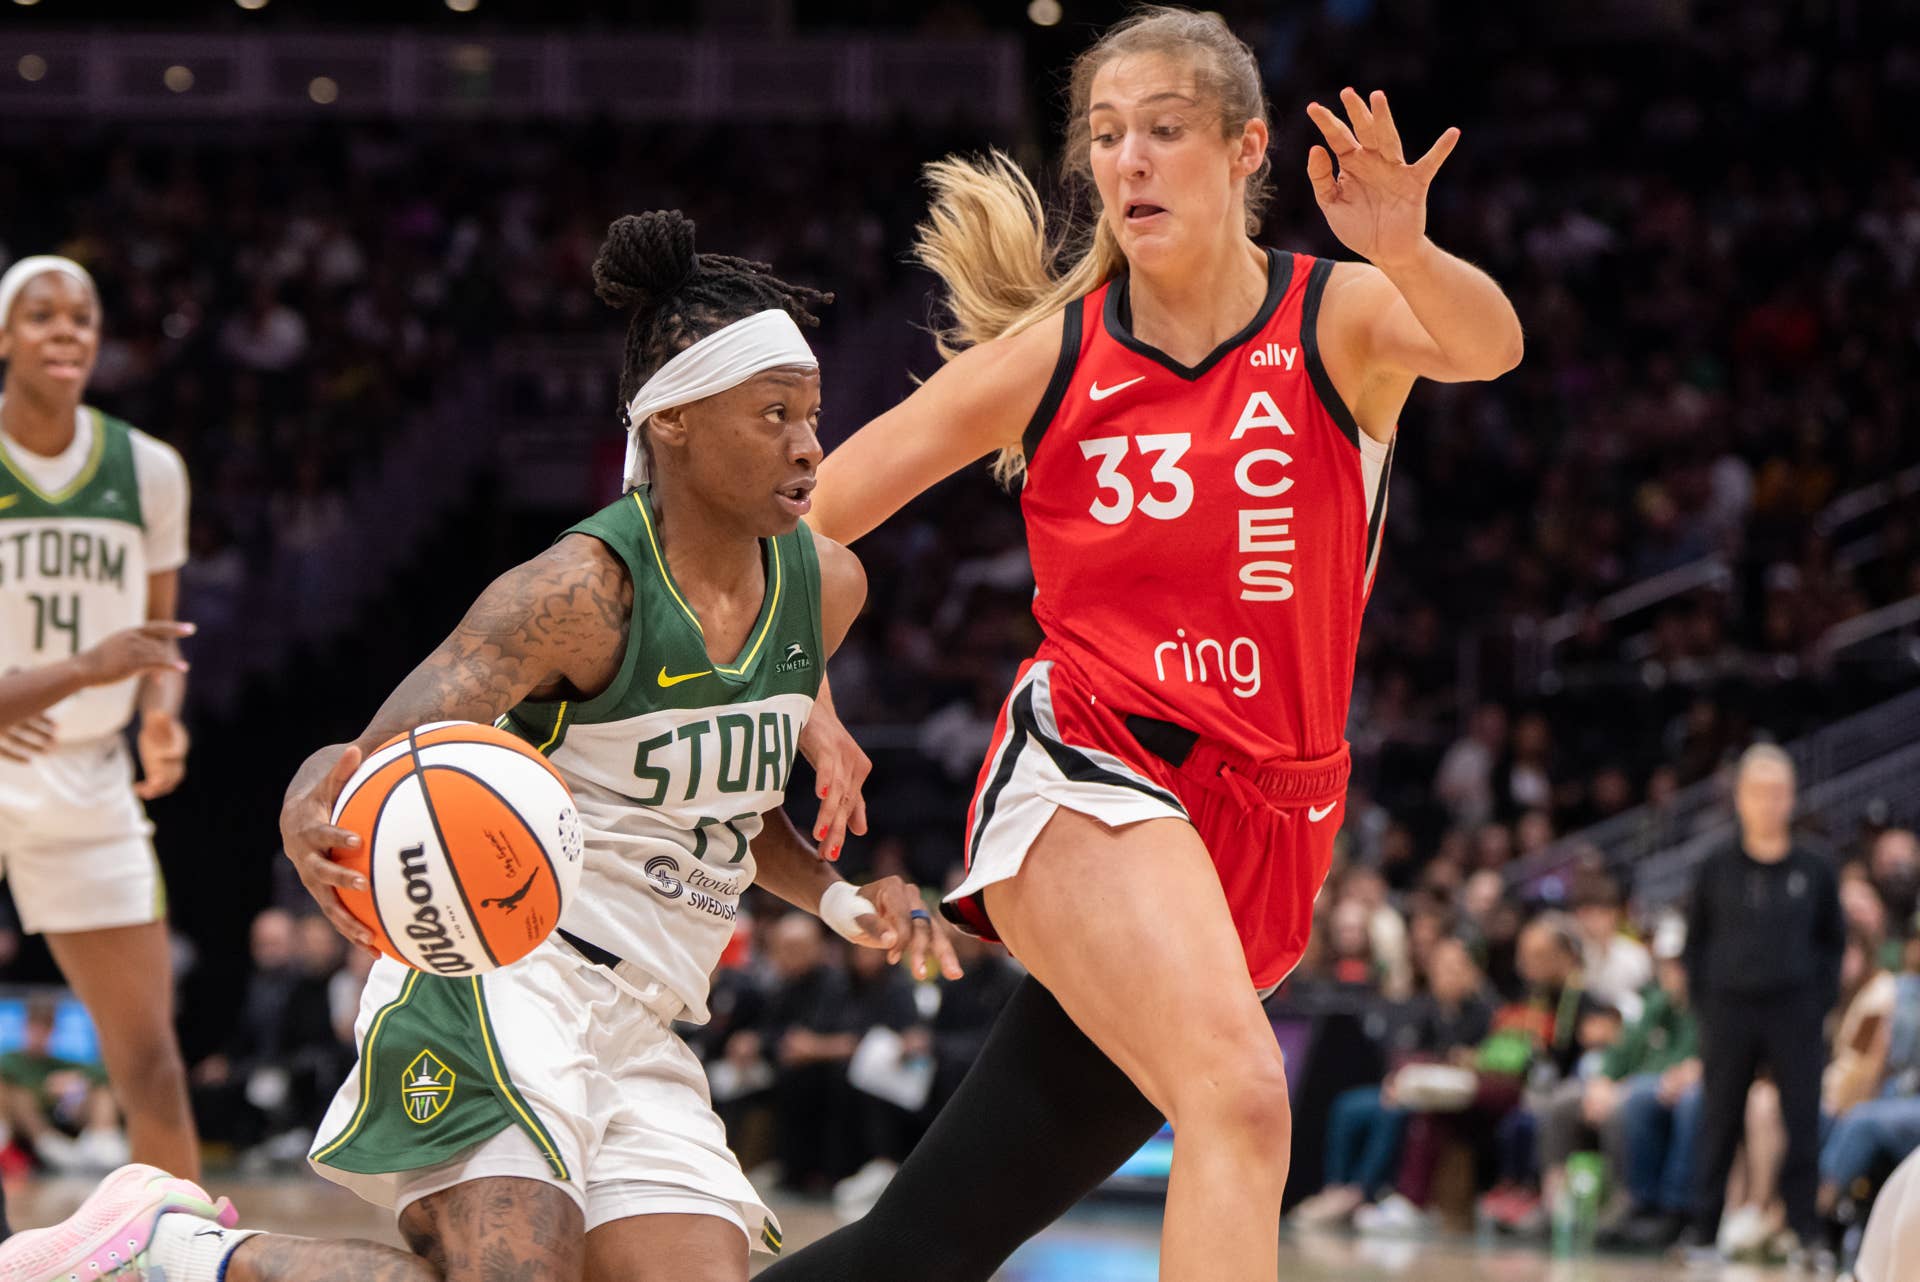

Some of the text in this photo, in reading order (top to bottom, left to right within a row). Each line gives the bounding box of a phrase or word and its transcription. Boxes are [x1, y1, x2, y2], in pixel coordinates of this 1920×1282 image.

[1249, 343, 1297, 370] ally
[1078, 432, 1195, 526] 33
[1229, 391, 1296, 602] ACES
[0, 529, 126, 593] TORM
[775, 658, 810, 673] SYMETRA
[1154, 628, 1262, 698] ring
[398, 841, 474, 974] Wilson
